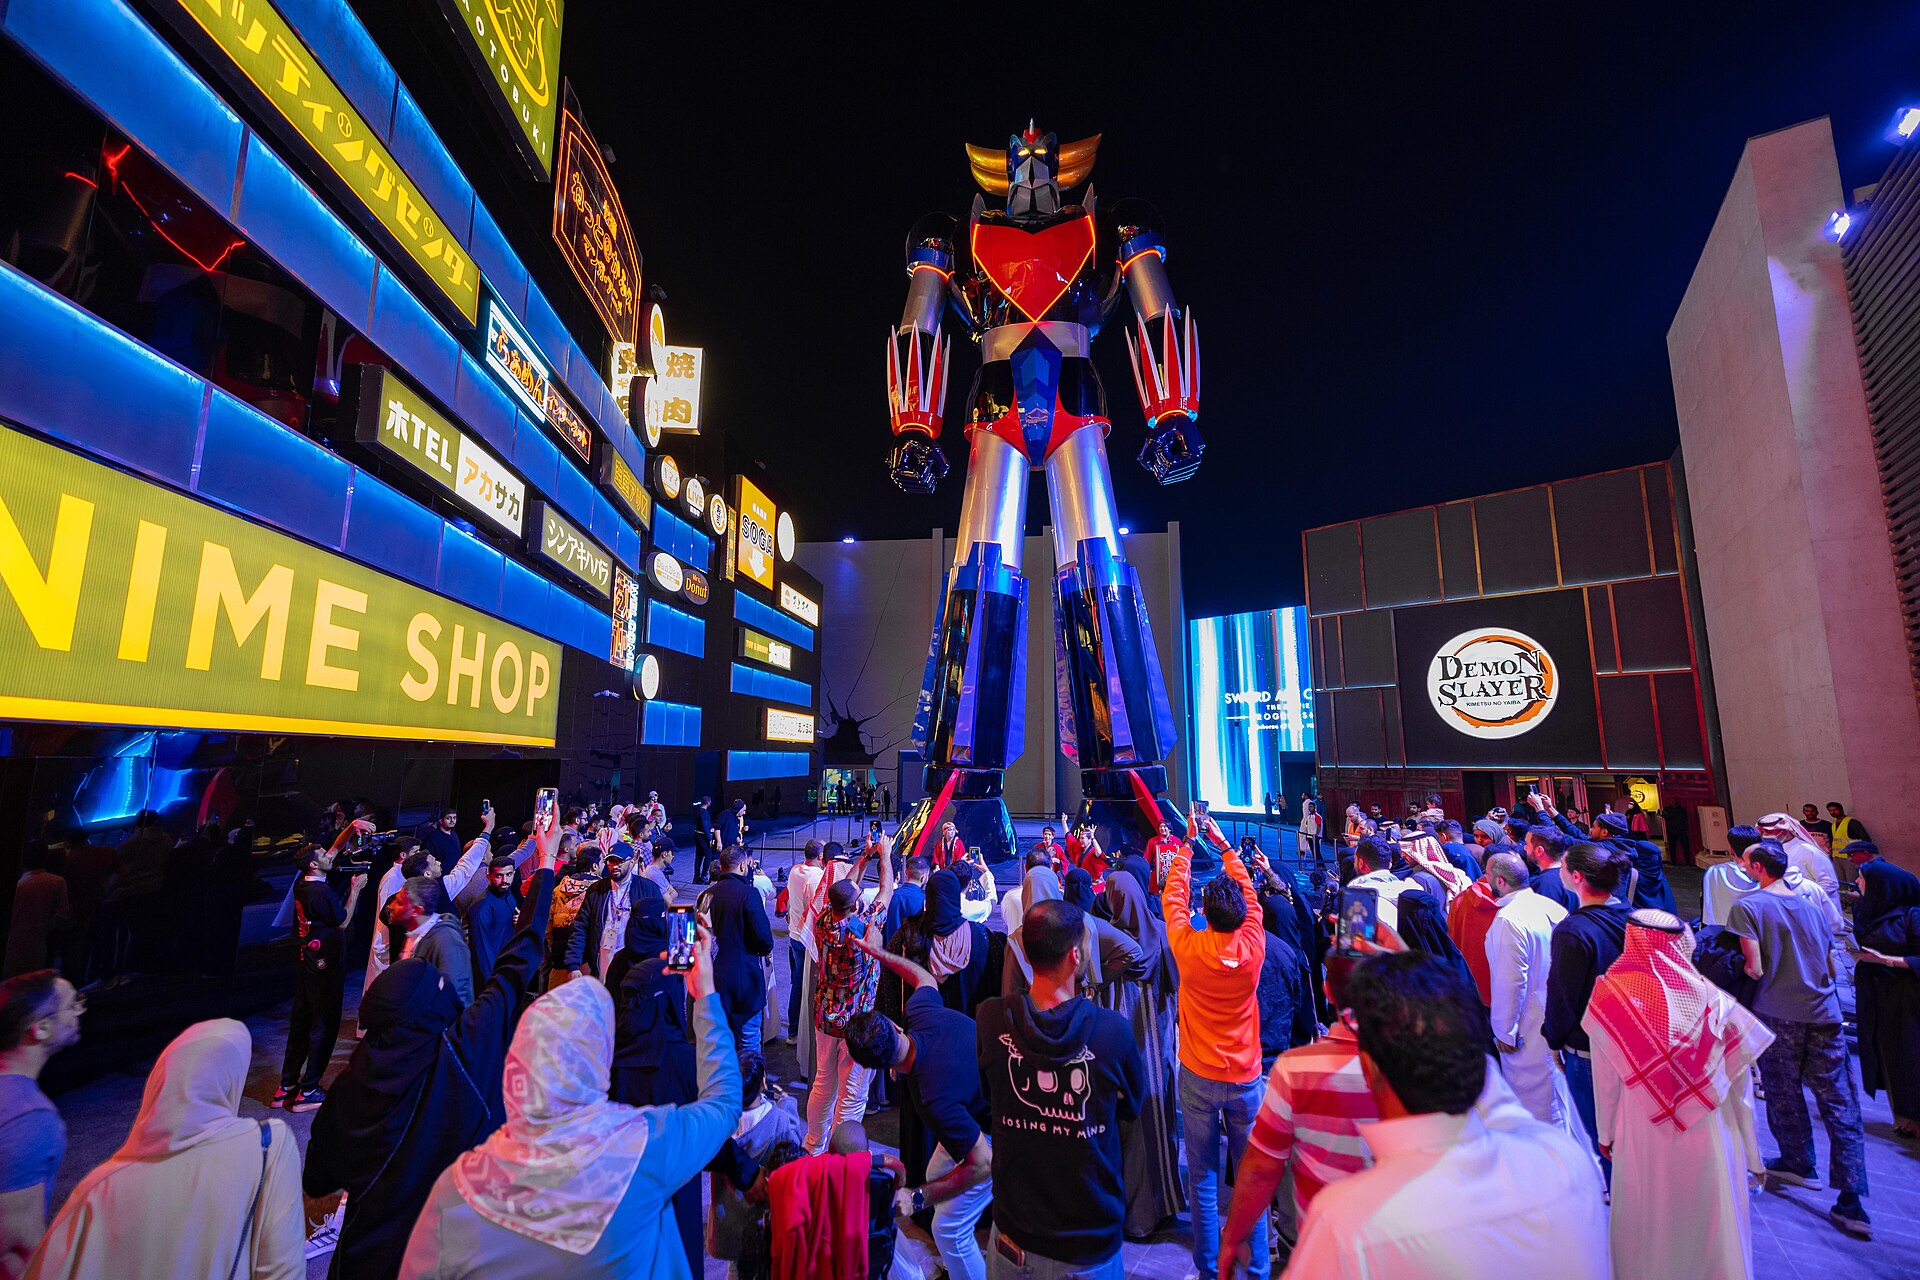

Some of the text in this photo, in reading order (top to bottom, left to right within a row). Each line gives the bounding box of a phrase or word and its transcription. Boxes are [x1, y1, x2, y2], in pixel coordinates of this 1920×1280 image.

[196, 0, 473, 293] ッティングセンター
[463, 455, 521, 522] アカサカ
[685, 576, 708, 599] Donut
[400, 612, 550, 717] SHOP
[1437, 649, 1549, 682] DEMON
[1437, 675, 1553, 707] SLAYER
[1053, 1125, 1070, 1136] MY
